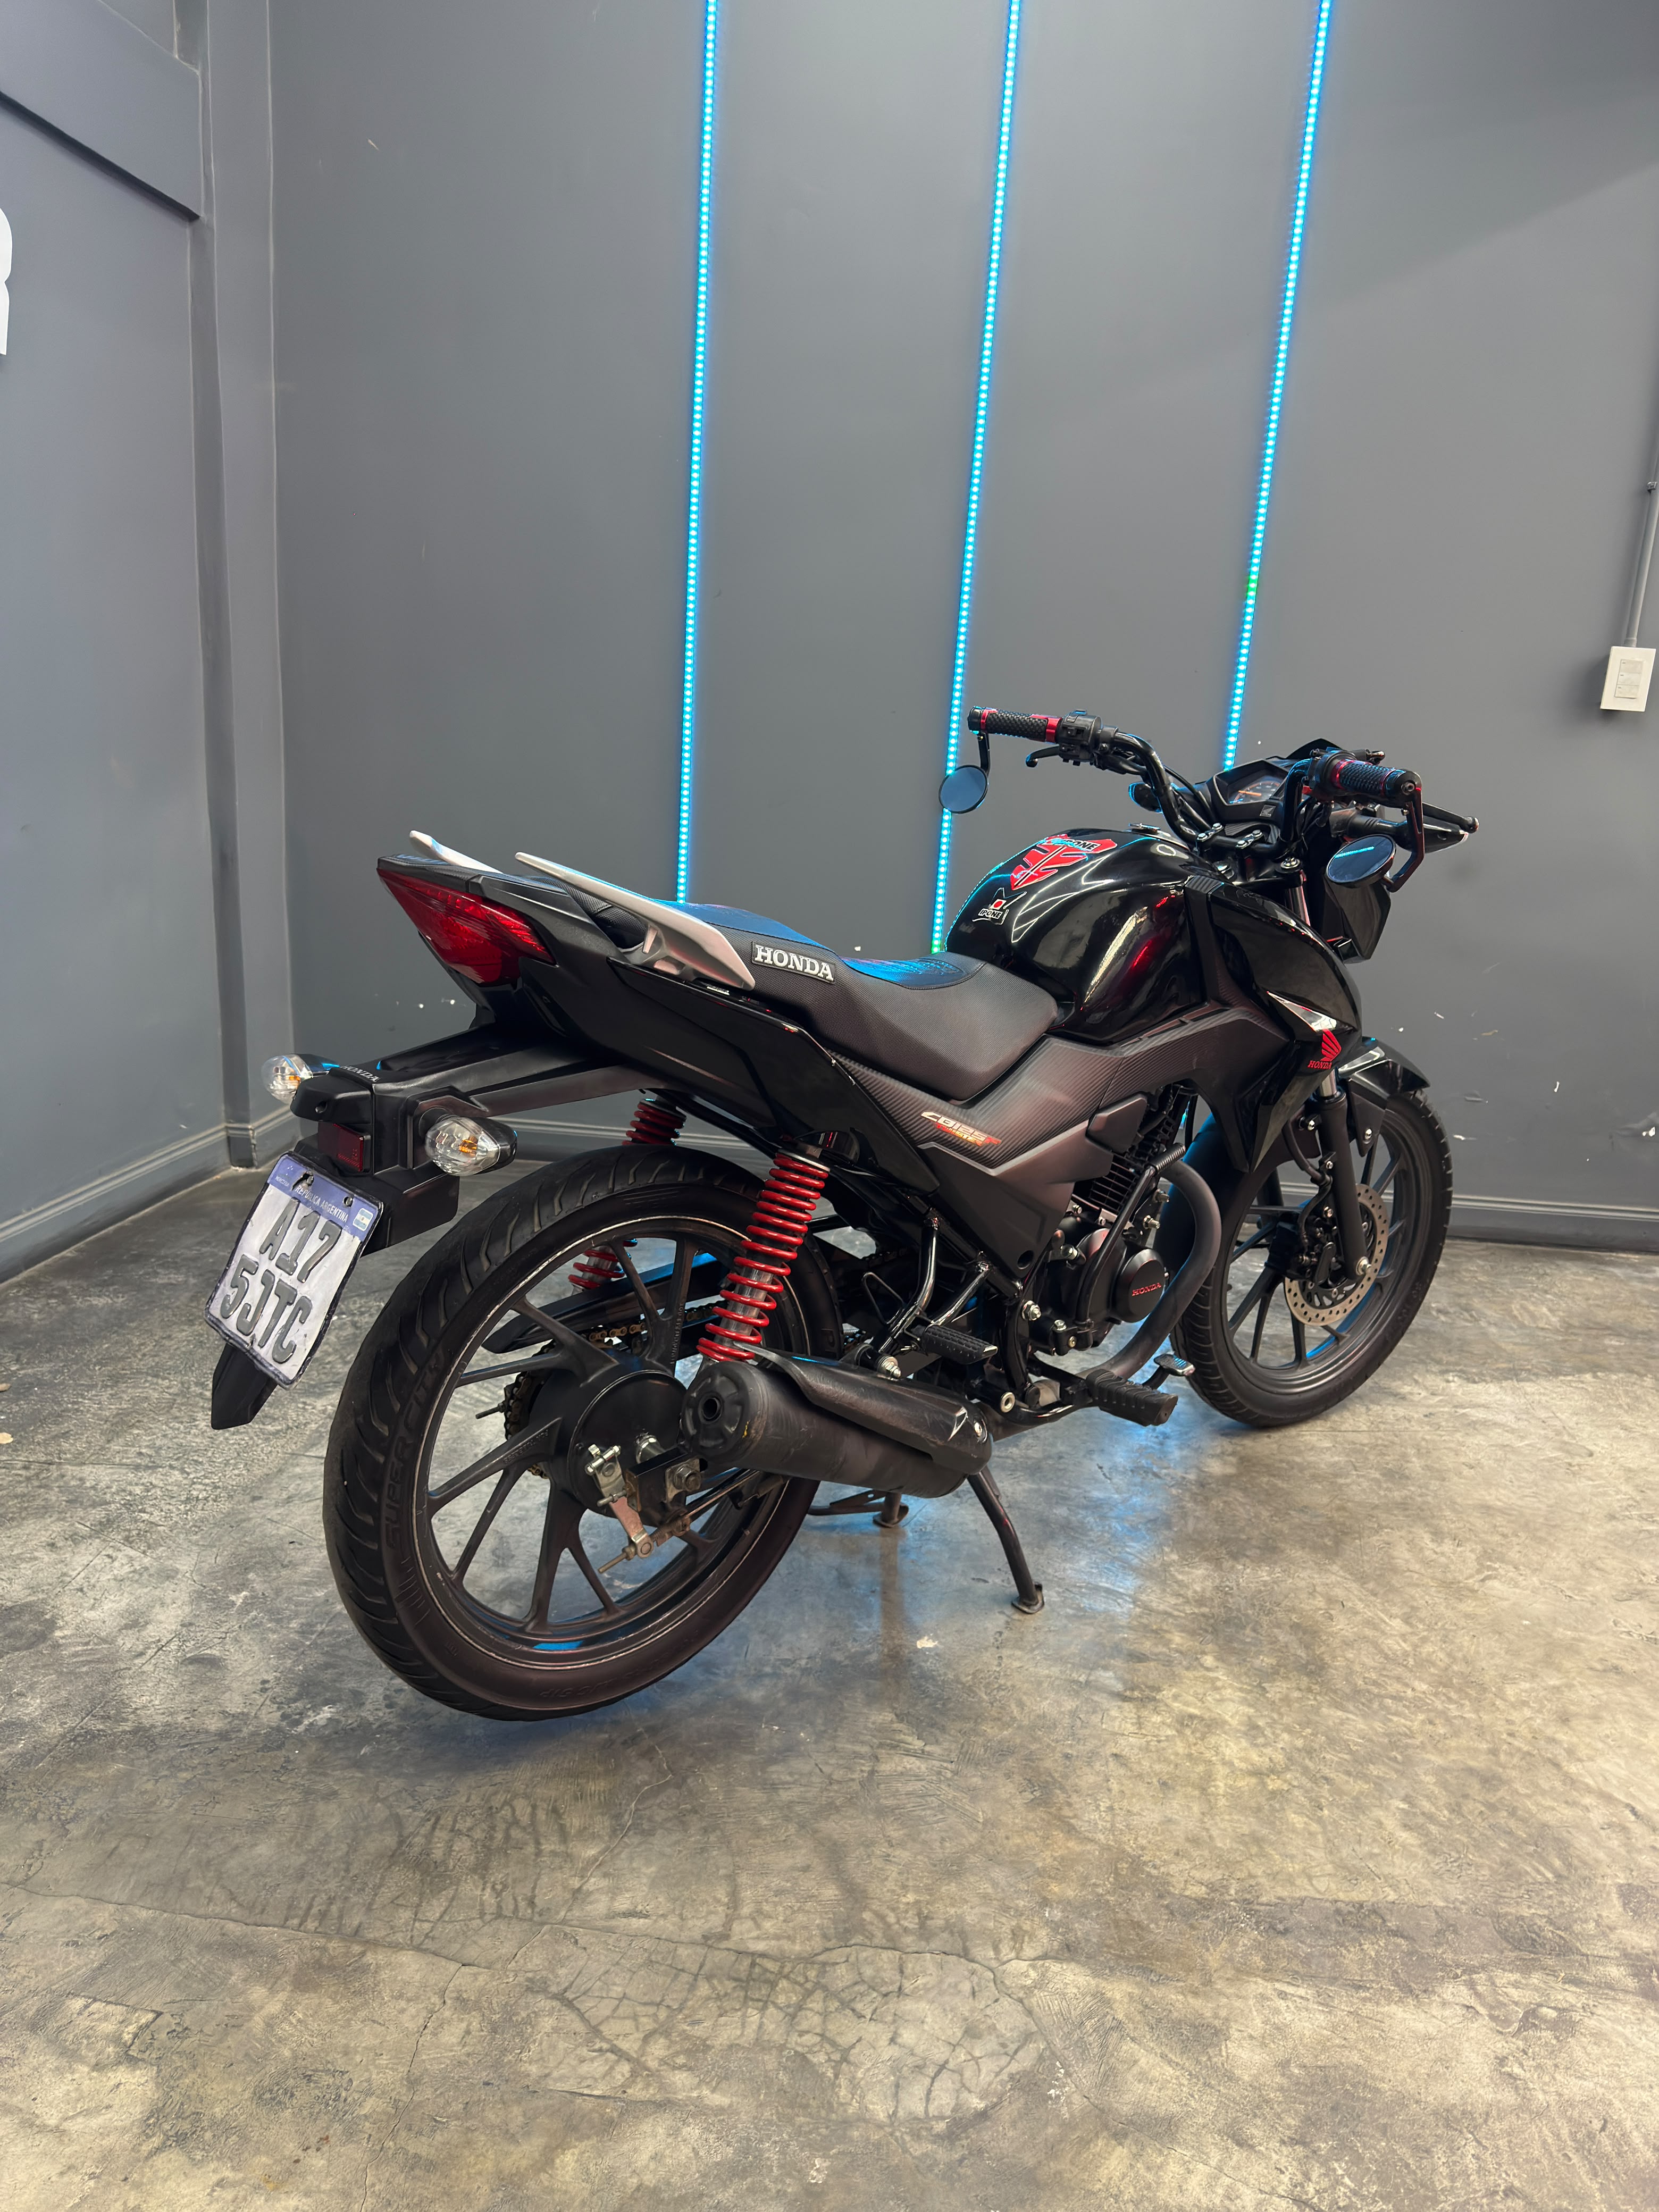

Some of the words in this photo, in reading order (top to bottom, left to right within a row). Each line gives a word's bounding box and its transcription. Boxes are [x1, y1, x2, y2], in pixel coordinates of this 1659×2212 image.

[979, 909, 1001, 918] IPONE
[755, 944, 834, 982] HONDA
[340, 1065, 379, 1082] HONDA
[1307, 1060, 1332, 1069] HONDA
[321, 1201, 349, 1222] ARGENTINA
[259, 1196, 343, 1283] A17
[1132, 1282, 1162, 1296] HONDA
[220, 1253, 313, 1363] 5JTC
[385, 1436, 410, 1549] SUPER
